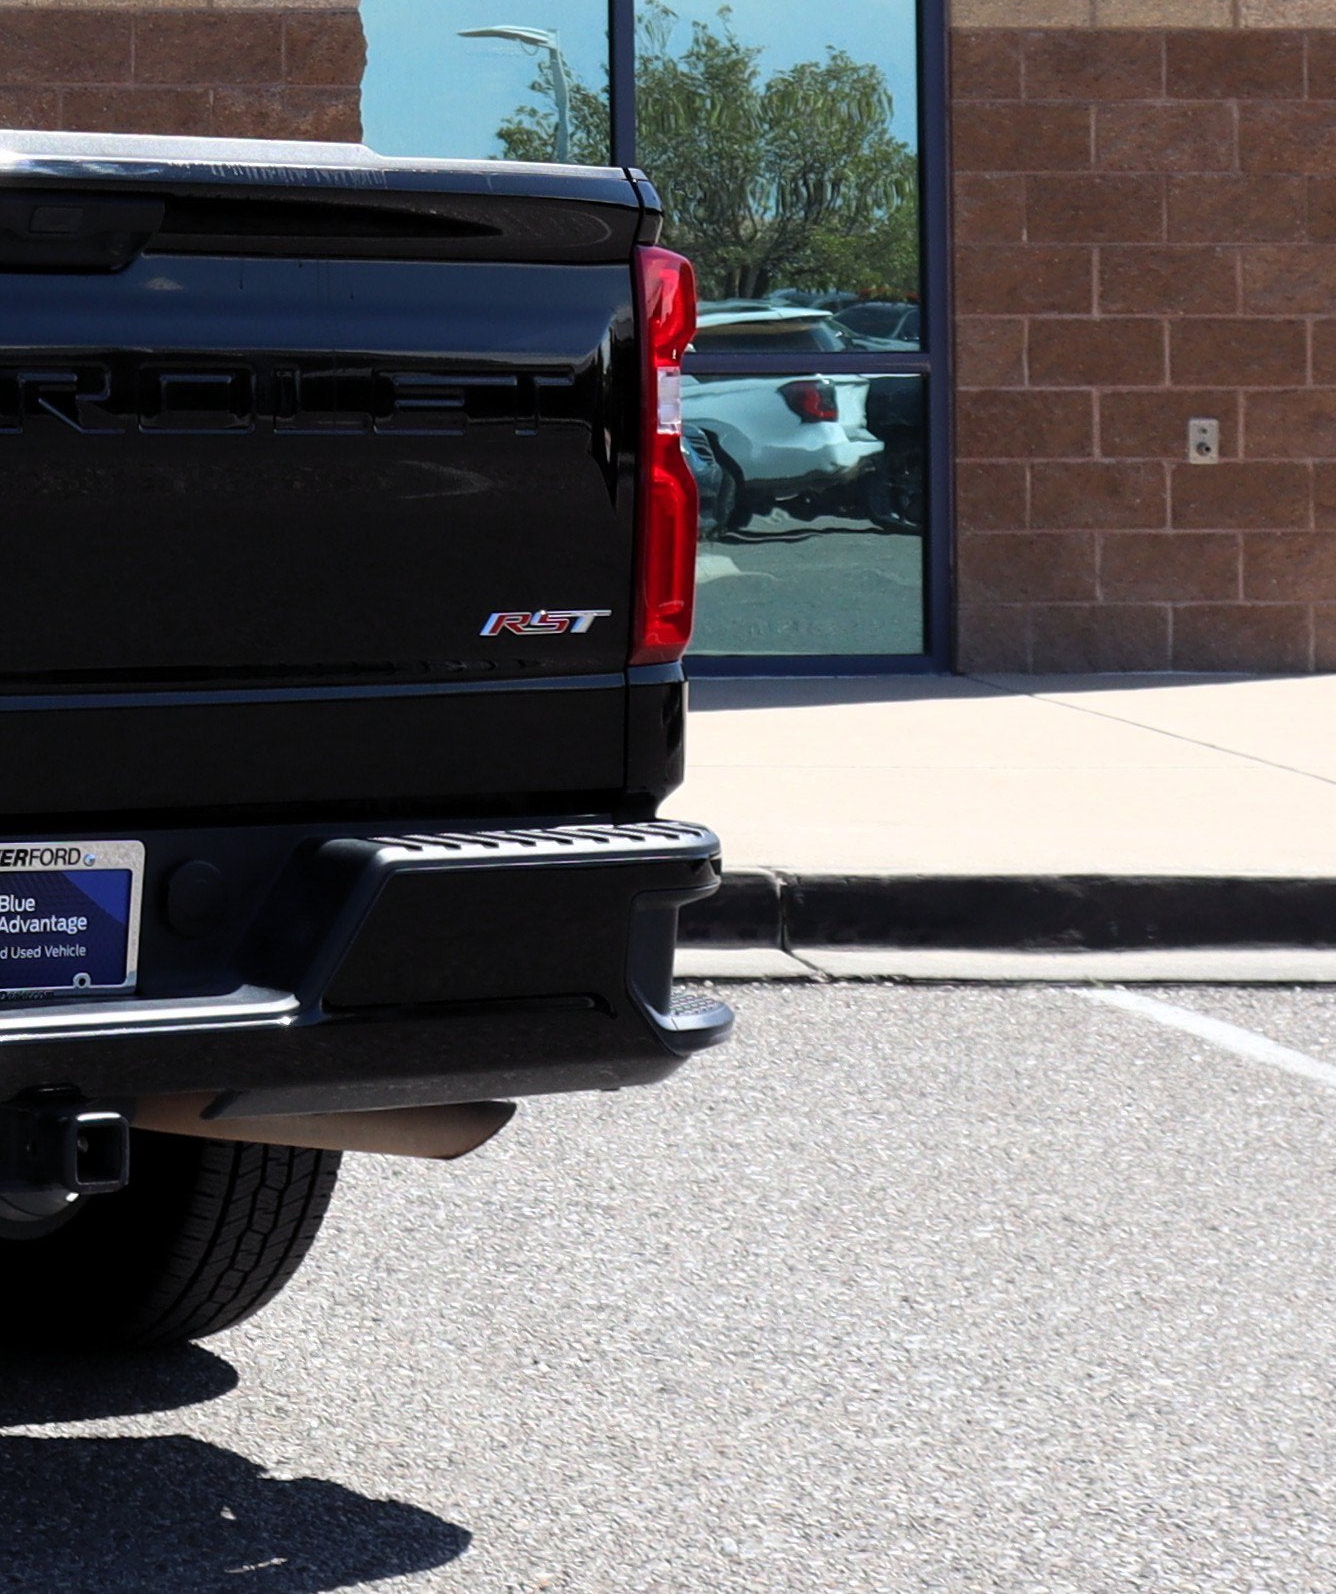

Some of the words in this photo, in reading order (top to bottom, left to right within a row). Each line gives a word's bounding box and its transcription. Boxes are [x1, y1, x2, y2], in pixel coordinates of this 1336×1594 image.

[479, 608, 613, 637] RST
[10, 945, 42, 960] Used
[44, 943, 87, 959] Vehicle
